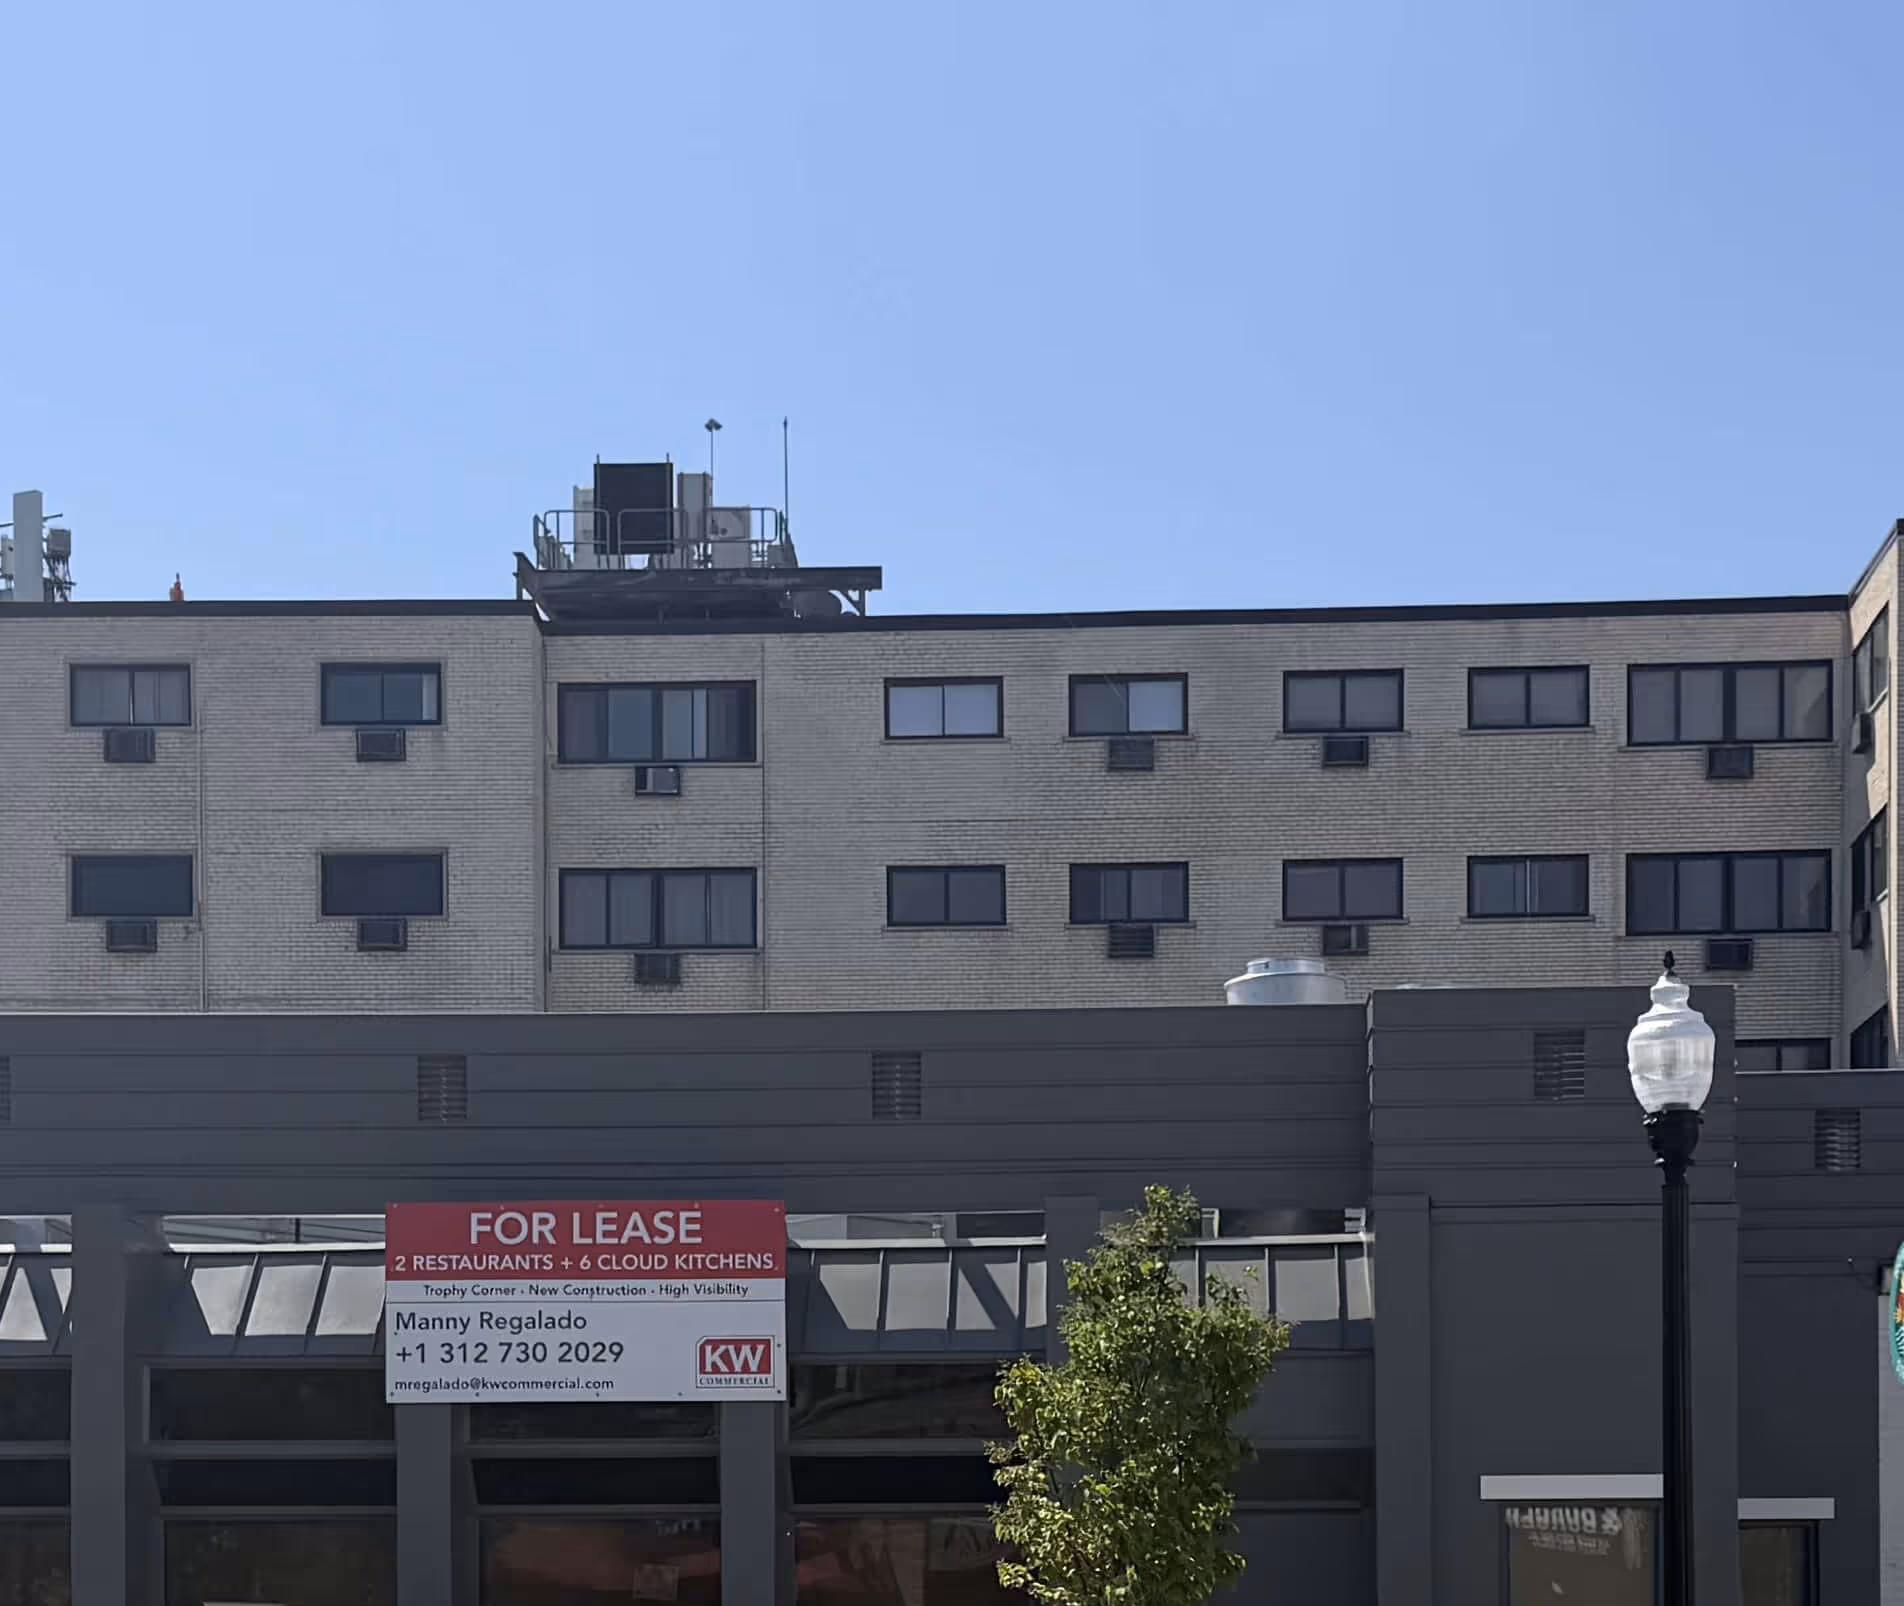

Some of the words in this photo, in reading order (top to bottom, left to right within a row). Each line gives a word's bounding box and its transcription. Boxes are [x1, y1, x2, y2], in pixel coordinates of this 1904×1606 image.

[470, 1211, 556, 1245] FOR
[572, 1211, 702, 1245] LEASE
[395, 1255, 406, 1271] 2
[413, 1254, 553, 1271] RESTAURANTS
[580, 1254, 591, 1270] 6
[598, 1253, 668, 1271] CLOUD
[675, 1253, 774, 1270] KITCHENS
[424, 1284, 467, 1298] Trophy
[471, 1284, 516, 1296] Corner
[529, 1284, 559, 1296] New
[563, 1284, 646, 1298] Construction
[659, 1284, 689, 1298] High
[694, 1283, 748, 1297] Visibility
[396, 1312, 471, 1335] Manny
[480, 1310, 587, 1335] Regalado
[396, 1343, 426, 1363] +1
[440, 1342, 488, 1363] 312
[498, 1342, 547, 1363] 730
[558, 1341, 624, 1363] 2029
[705, 1344, 765, 1372] KW
[395, 1377, 614, 1393] mregalado@kwcommercial.com
[699, 1377, 769, 1385] COMMERCIAL
